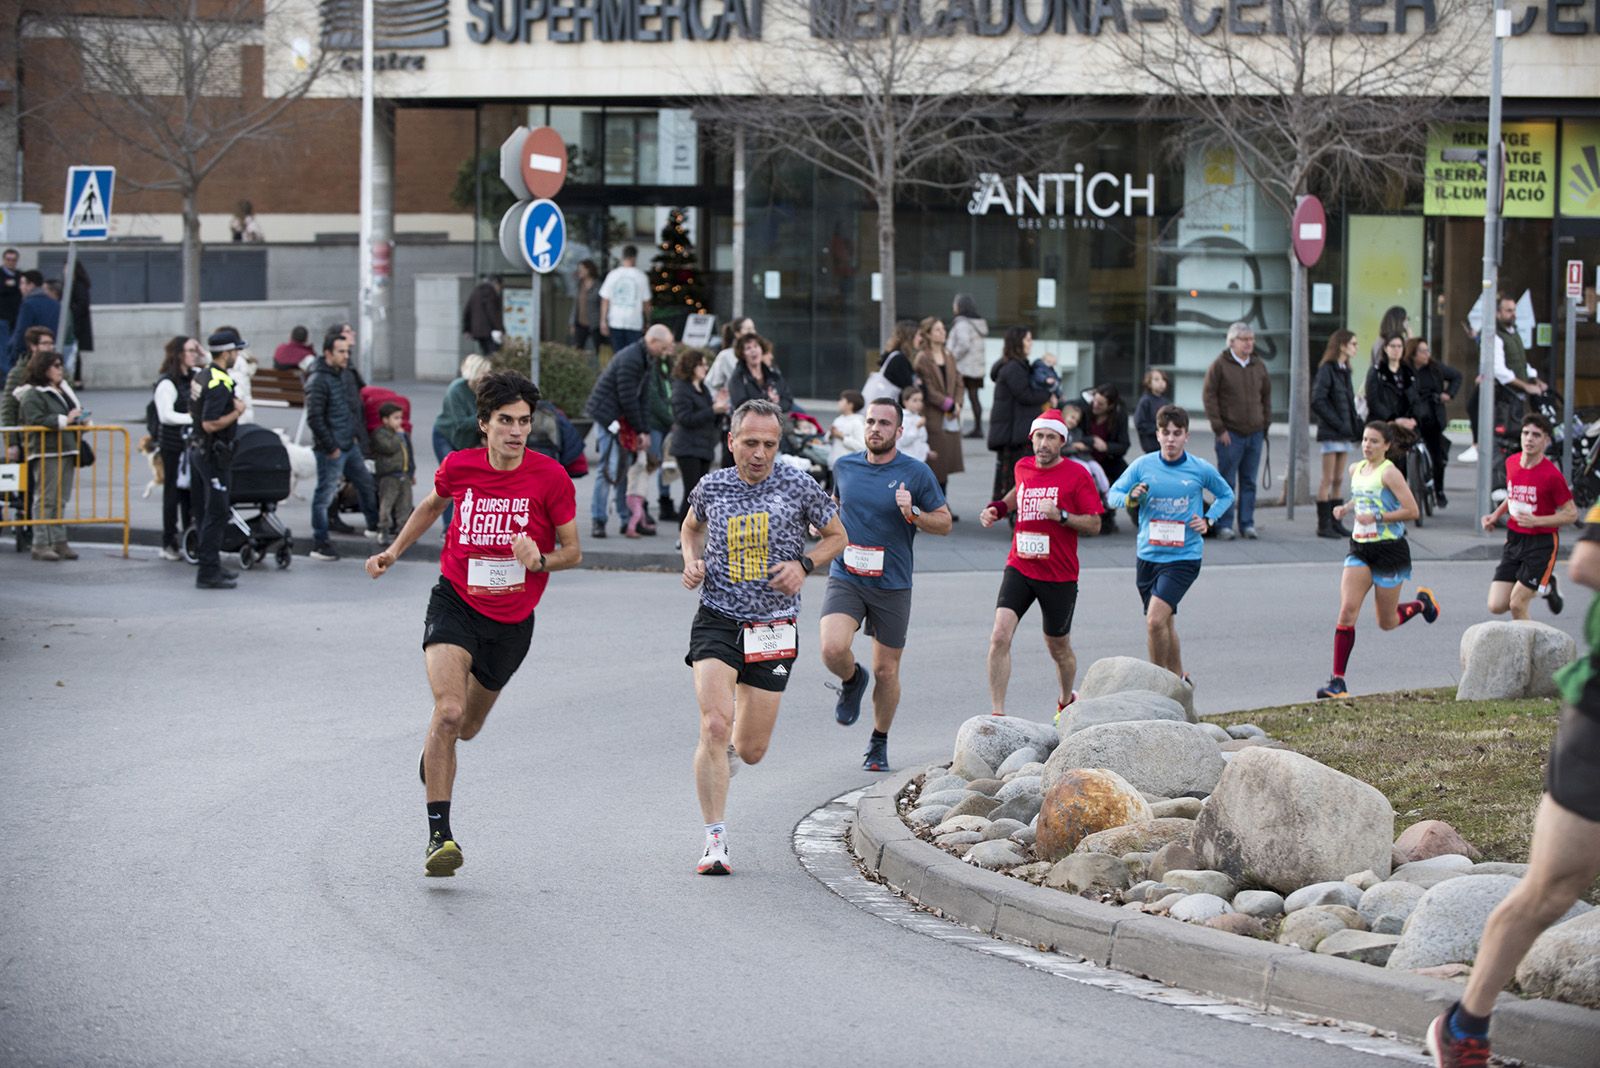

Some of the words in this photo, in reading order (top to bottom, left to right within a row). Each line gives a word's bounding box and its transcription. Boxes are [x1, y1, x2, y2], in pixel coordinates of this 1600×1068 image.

[476, 498, 510, 513] CURSA
[512, 498, 529, 512] DEL
[472, 513, 513, 534] GALL
[471, 533, 496, 546] SANT
[1020, 541, 1045, 552] 2103
[489, 569, 507, 577] PAU
[489, 577, 507, 586] 525
